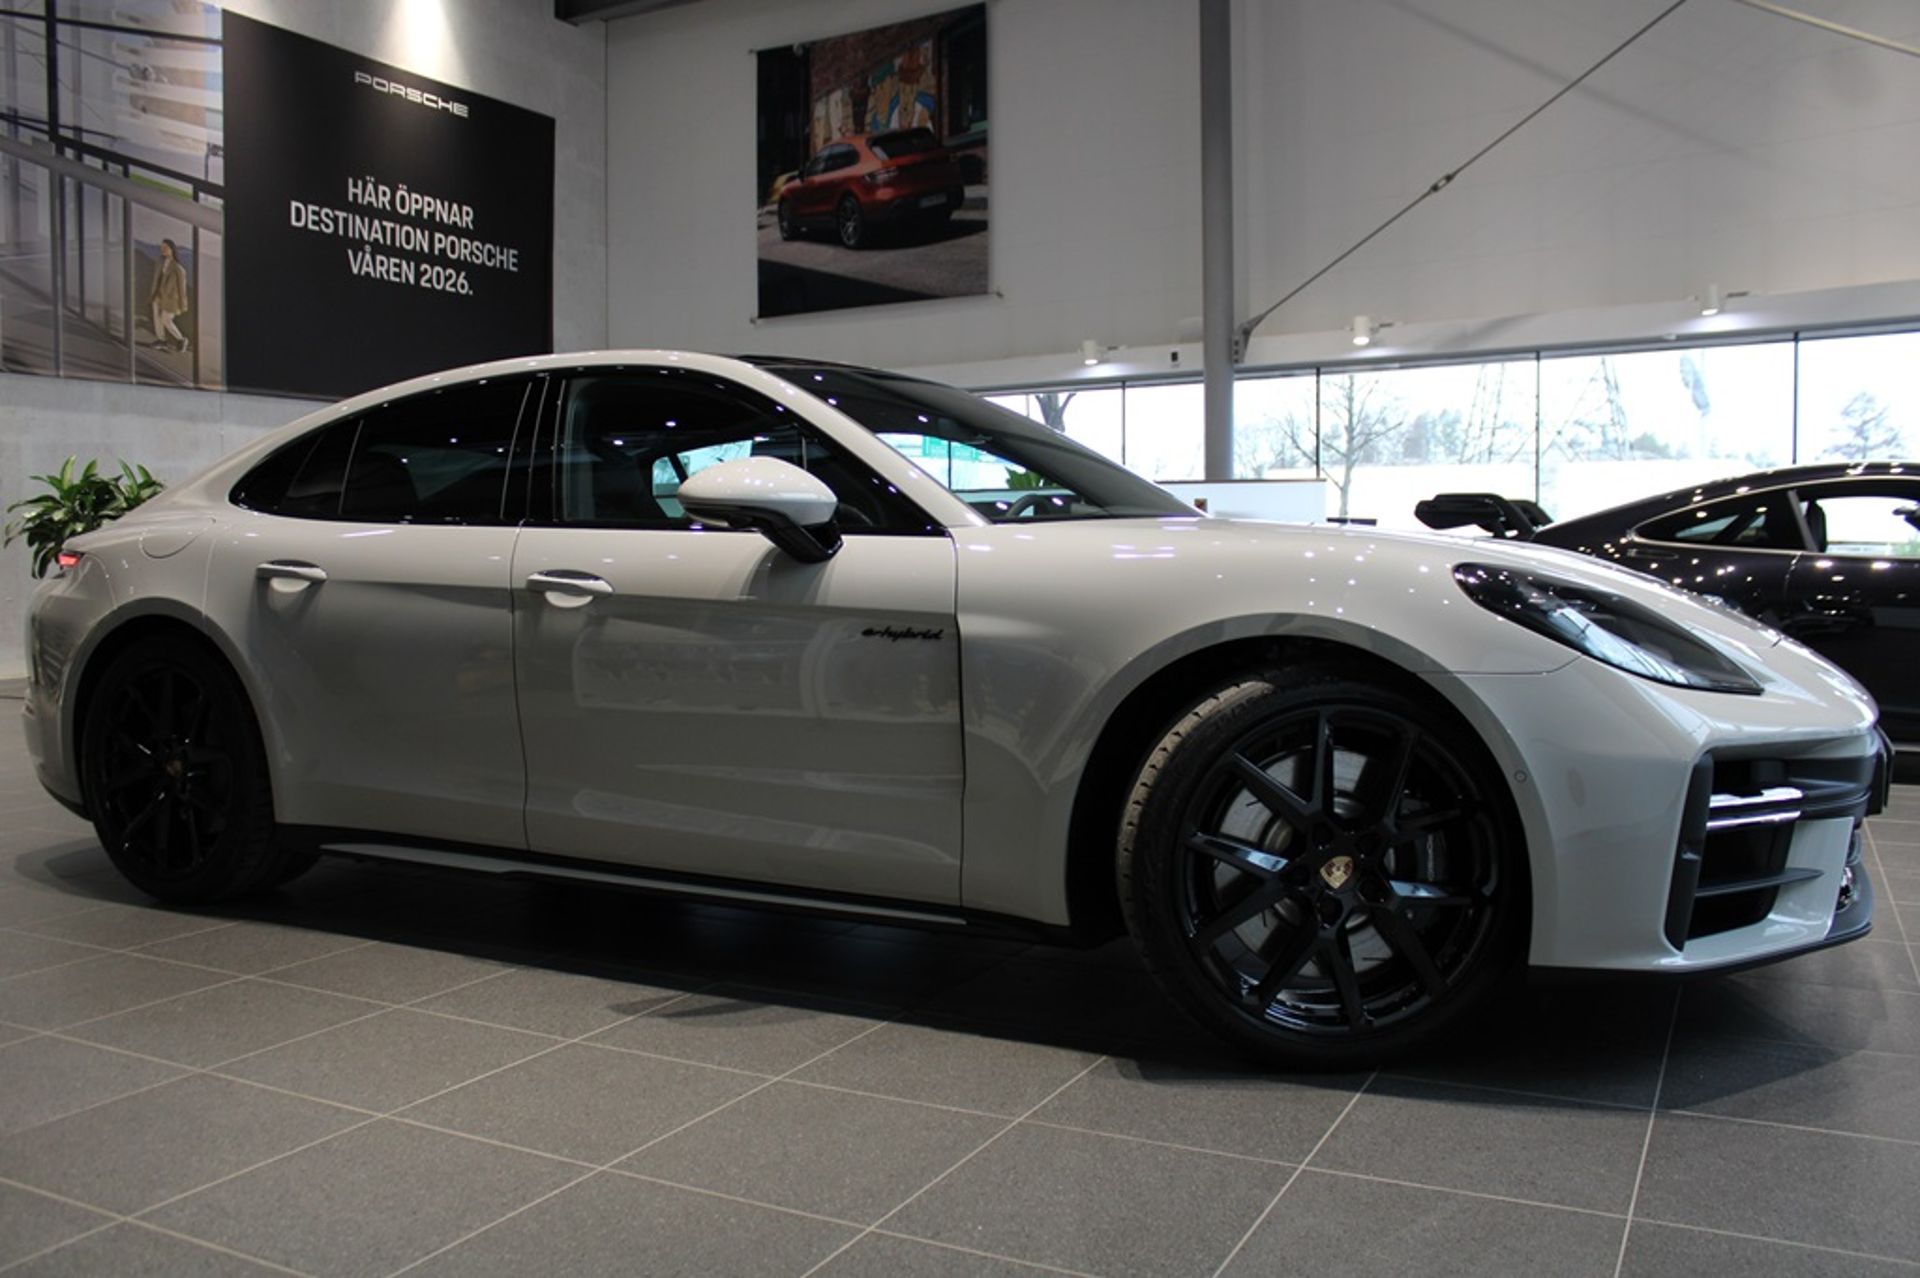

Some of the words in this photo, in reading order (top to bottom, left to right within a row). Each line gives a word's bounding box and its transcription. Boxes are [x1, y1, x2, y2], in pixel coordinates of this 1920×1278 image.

[354, 70, 469, 118] PORSCHE
[347, 175, 391, 211] HÄR
[395, 183, 474, 230] ÖPPNAR
[290, 200, 429, 254] DESTINATION
[433, 231, 519, 273] PORSCHE
[347, 244, 415, 286] VÅREN
[419, 263, 474, 296] 2026.
